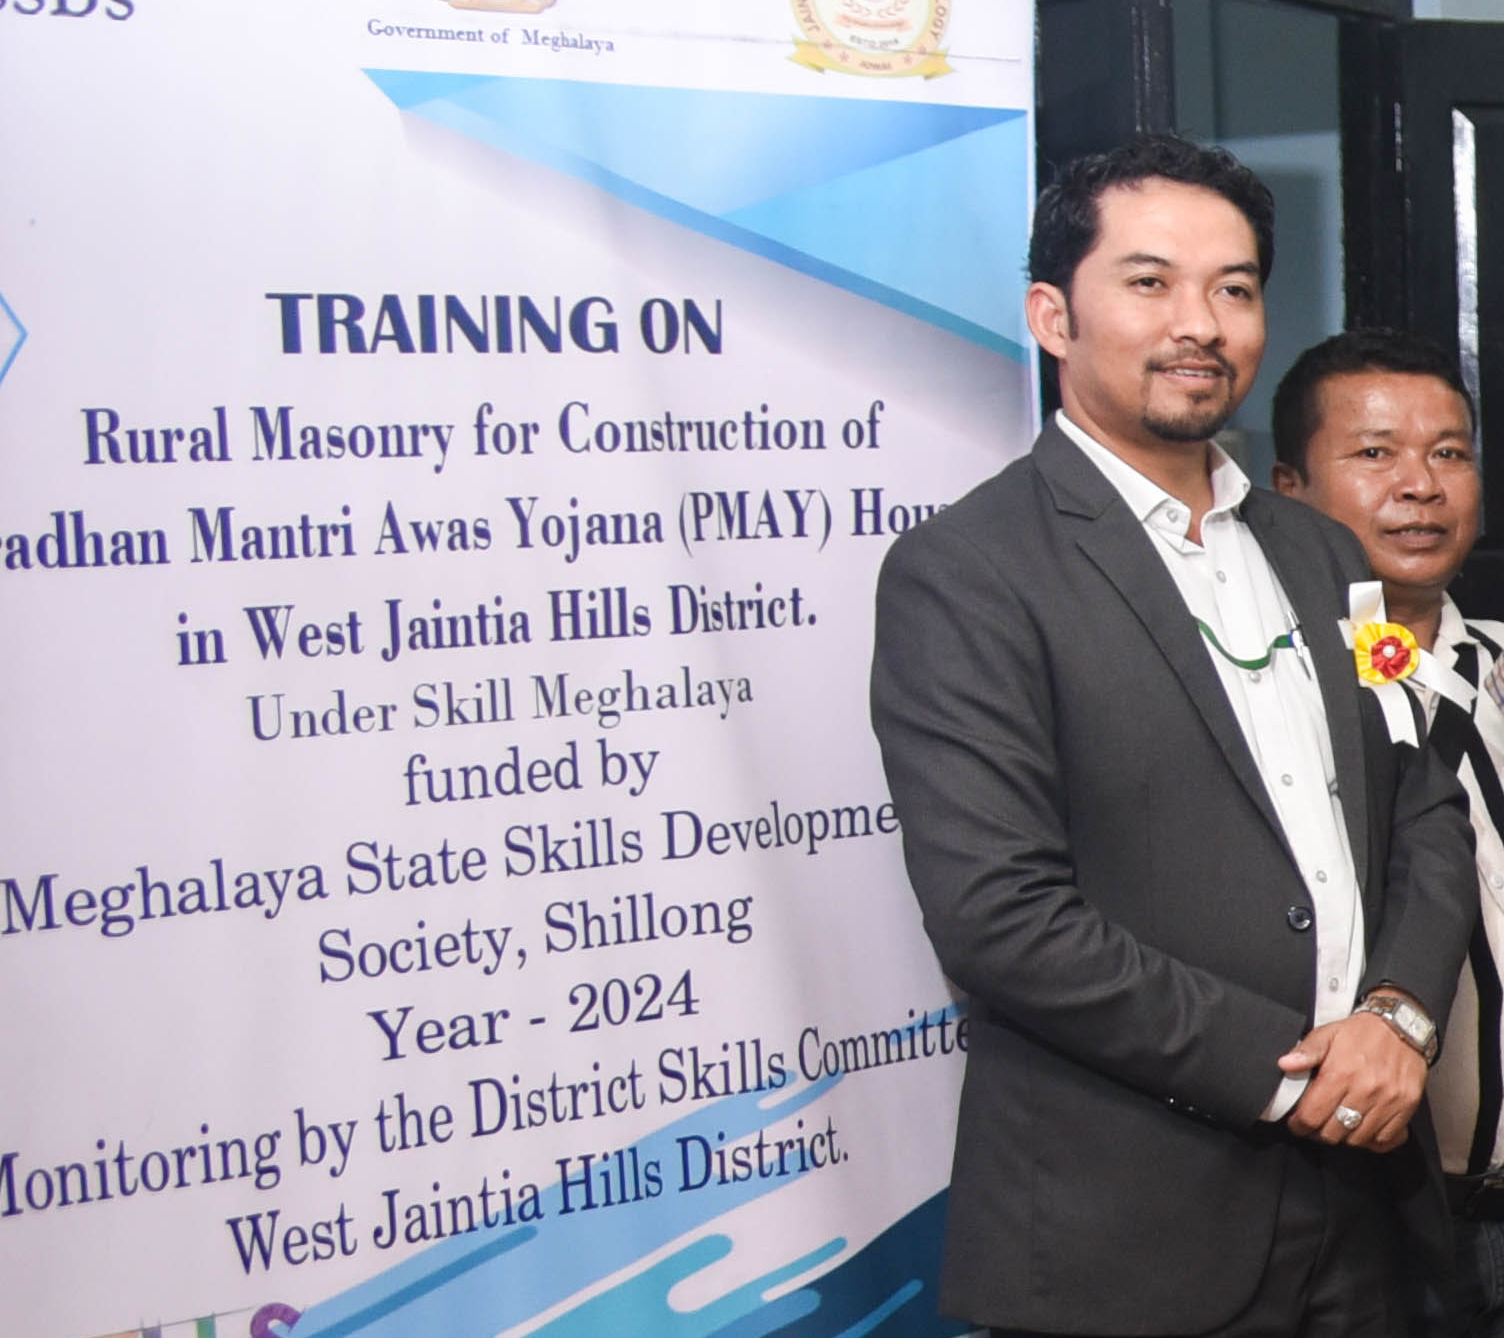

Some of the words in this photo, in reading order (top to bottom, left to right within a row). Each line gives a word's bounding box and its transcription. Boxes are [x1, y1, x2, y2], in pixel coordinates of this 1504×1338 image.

[367, 18, 485, 44] Government
[490, 26, 510, 46] of
[521, 28, 616, 56] Meghalaya
[265, 292, 620, 355] TRAINING
[640, 297, 724, 355] ON
[81, 405, 233, 465] Rural
[249, 405, 455, 474] Masonry
[473, 401, 540, 456] for
[558, 400, 827, 454] Construction
[842, 399, 885, 449] of
[188, 504, 357, 563] Mantri
[374, 500, 492, 556] Awas
[505, 495, 665, 564] Yojana
[678, 488, 833, 558] (PMAY)
[849, 487, 949, 536] Hou
[176, 612, 229, 666] in
[243, 604, 365, 661] West
[381, 595, 533, 663] Jaintia
[548, 586, 652, 642] Hills
[668, 582, 818, 636] District.
[246, 689, 399, 742] Under
[413, 677, 515, 729] Skill
[530, 665, 755, 730] Meghalaya
[403, 740, 584, 806] funded
[596, 737, 661, 798] by
[0, 858, 330, 939] Meghalaya
[346, 838, 489, 896] State
[504, 817, 644, 878] Skills
[318, 917, 529, 984] Society,
[544, 892, 754, 954] Shillong
[366, 1006, 511, 1061] Year
[529, 1015, 547, 1027] -
[569, 969, 701, 1034] 2024
[293, 1107, 359, 1178] by
[374, 1092, 454, 1153] the
[468, 1061, 646, 1138] District
[658, 1038, 787, 1106] Skills
[226, 1203, 359, 1275] West
[372, 1169, 545, 1250] Jaintia
[556, 1146, 664, 1216] Hills
[676, 1115, 850, 1194] District.
